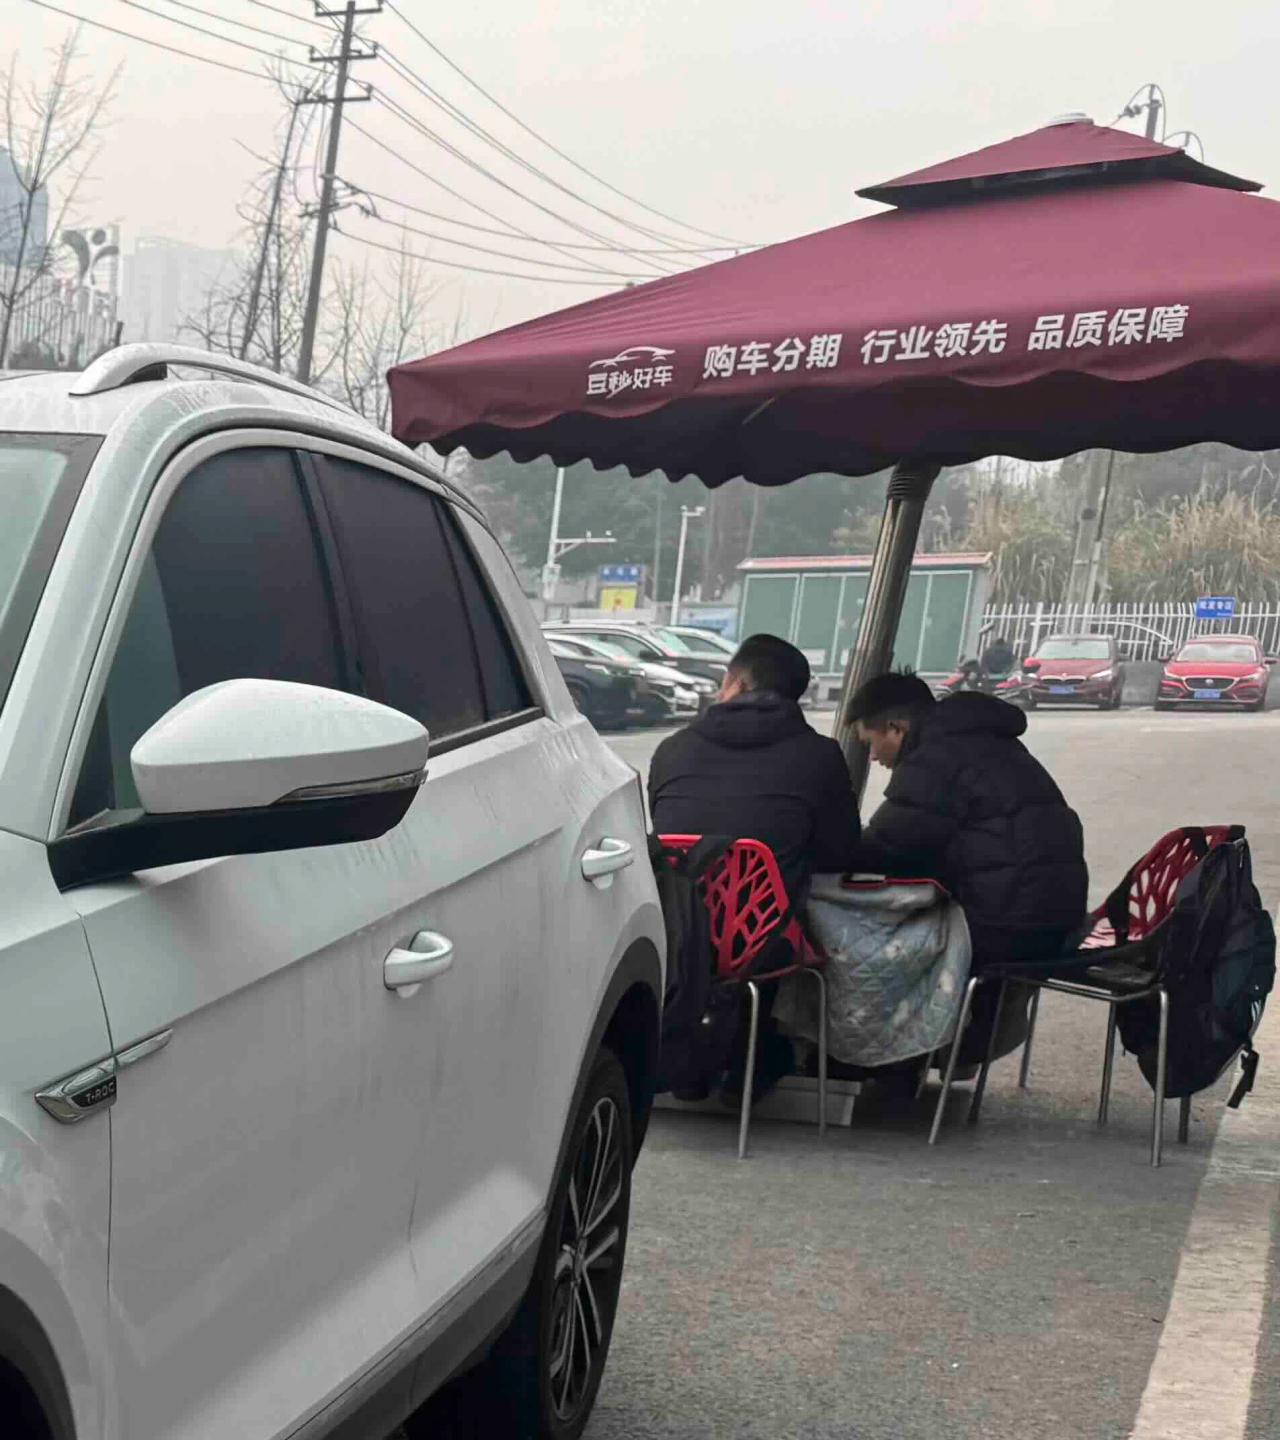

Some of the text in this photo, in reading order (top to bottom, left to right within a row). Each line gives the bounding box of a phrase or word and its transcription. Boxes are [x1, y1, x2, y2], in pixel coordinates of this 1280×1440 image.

[702, 303, 1190, 380] 购车分期 行业领先 品质保障
[86, 1081, 116, 1104] T-ROC
